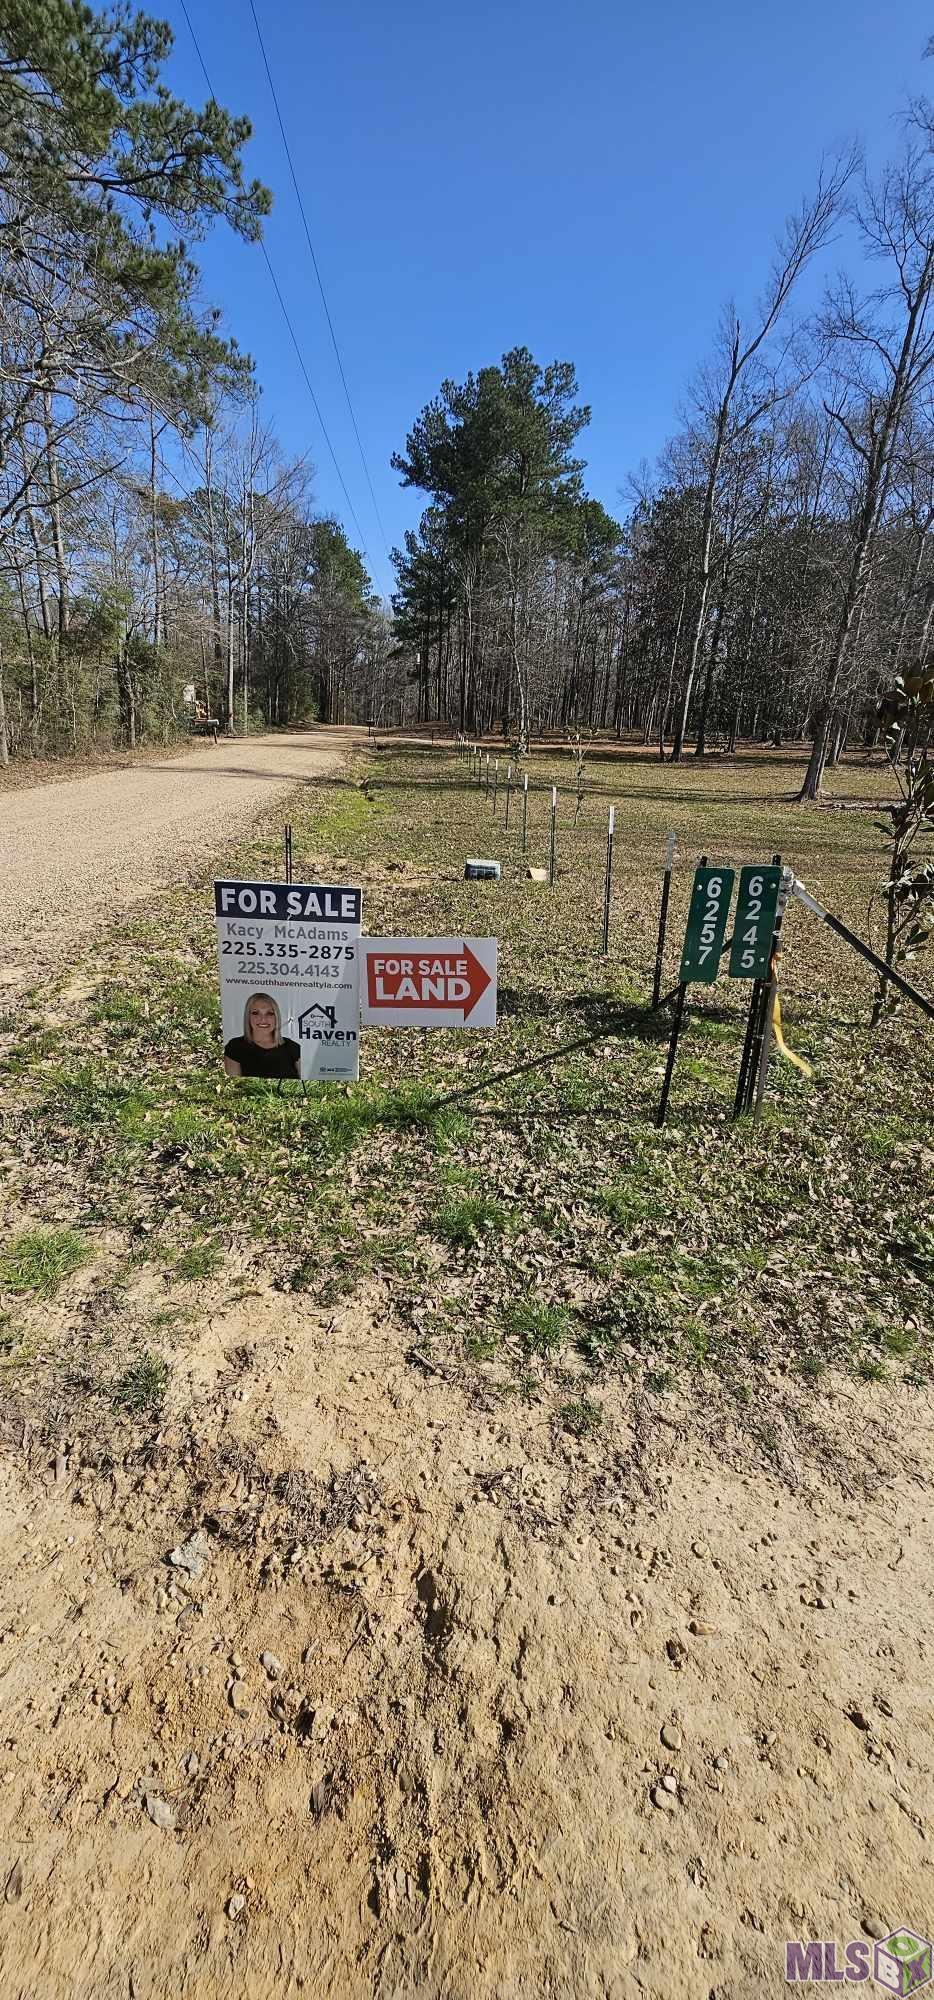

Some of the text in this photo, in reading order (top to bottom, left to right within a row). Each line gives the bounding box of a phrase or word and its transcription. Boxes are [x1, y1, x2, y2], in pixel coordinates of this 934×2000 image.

[221, 888, 356, 917] FOR SALE
[698, 877, 722, 965] 6257
[739, 875, 764, 969] 6245
[226, 922, 349, 941] Kacy McAdams
[222, 940, 355, 960] 225.335-2875
[237, 961, 340, 978] 225.304.4143
[374, 959, 468, 975] FOR SALE
[226, 977, 352, 989] www.southhavenrealtyla.com
[375, 977, 471, 1001] LAND
[303, 1019, 331, 1027] SOUTH
[298, 1027, 357, 1041] Haven
